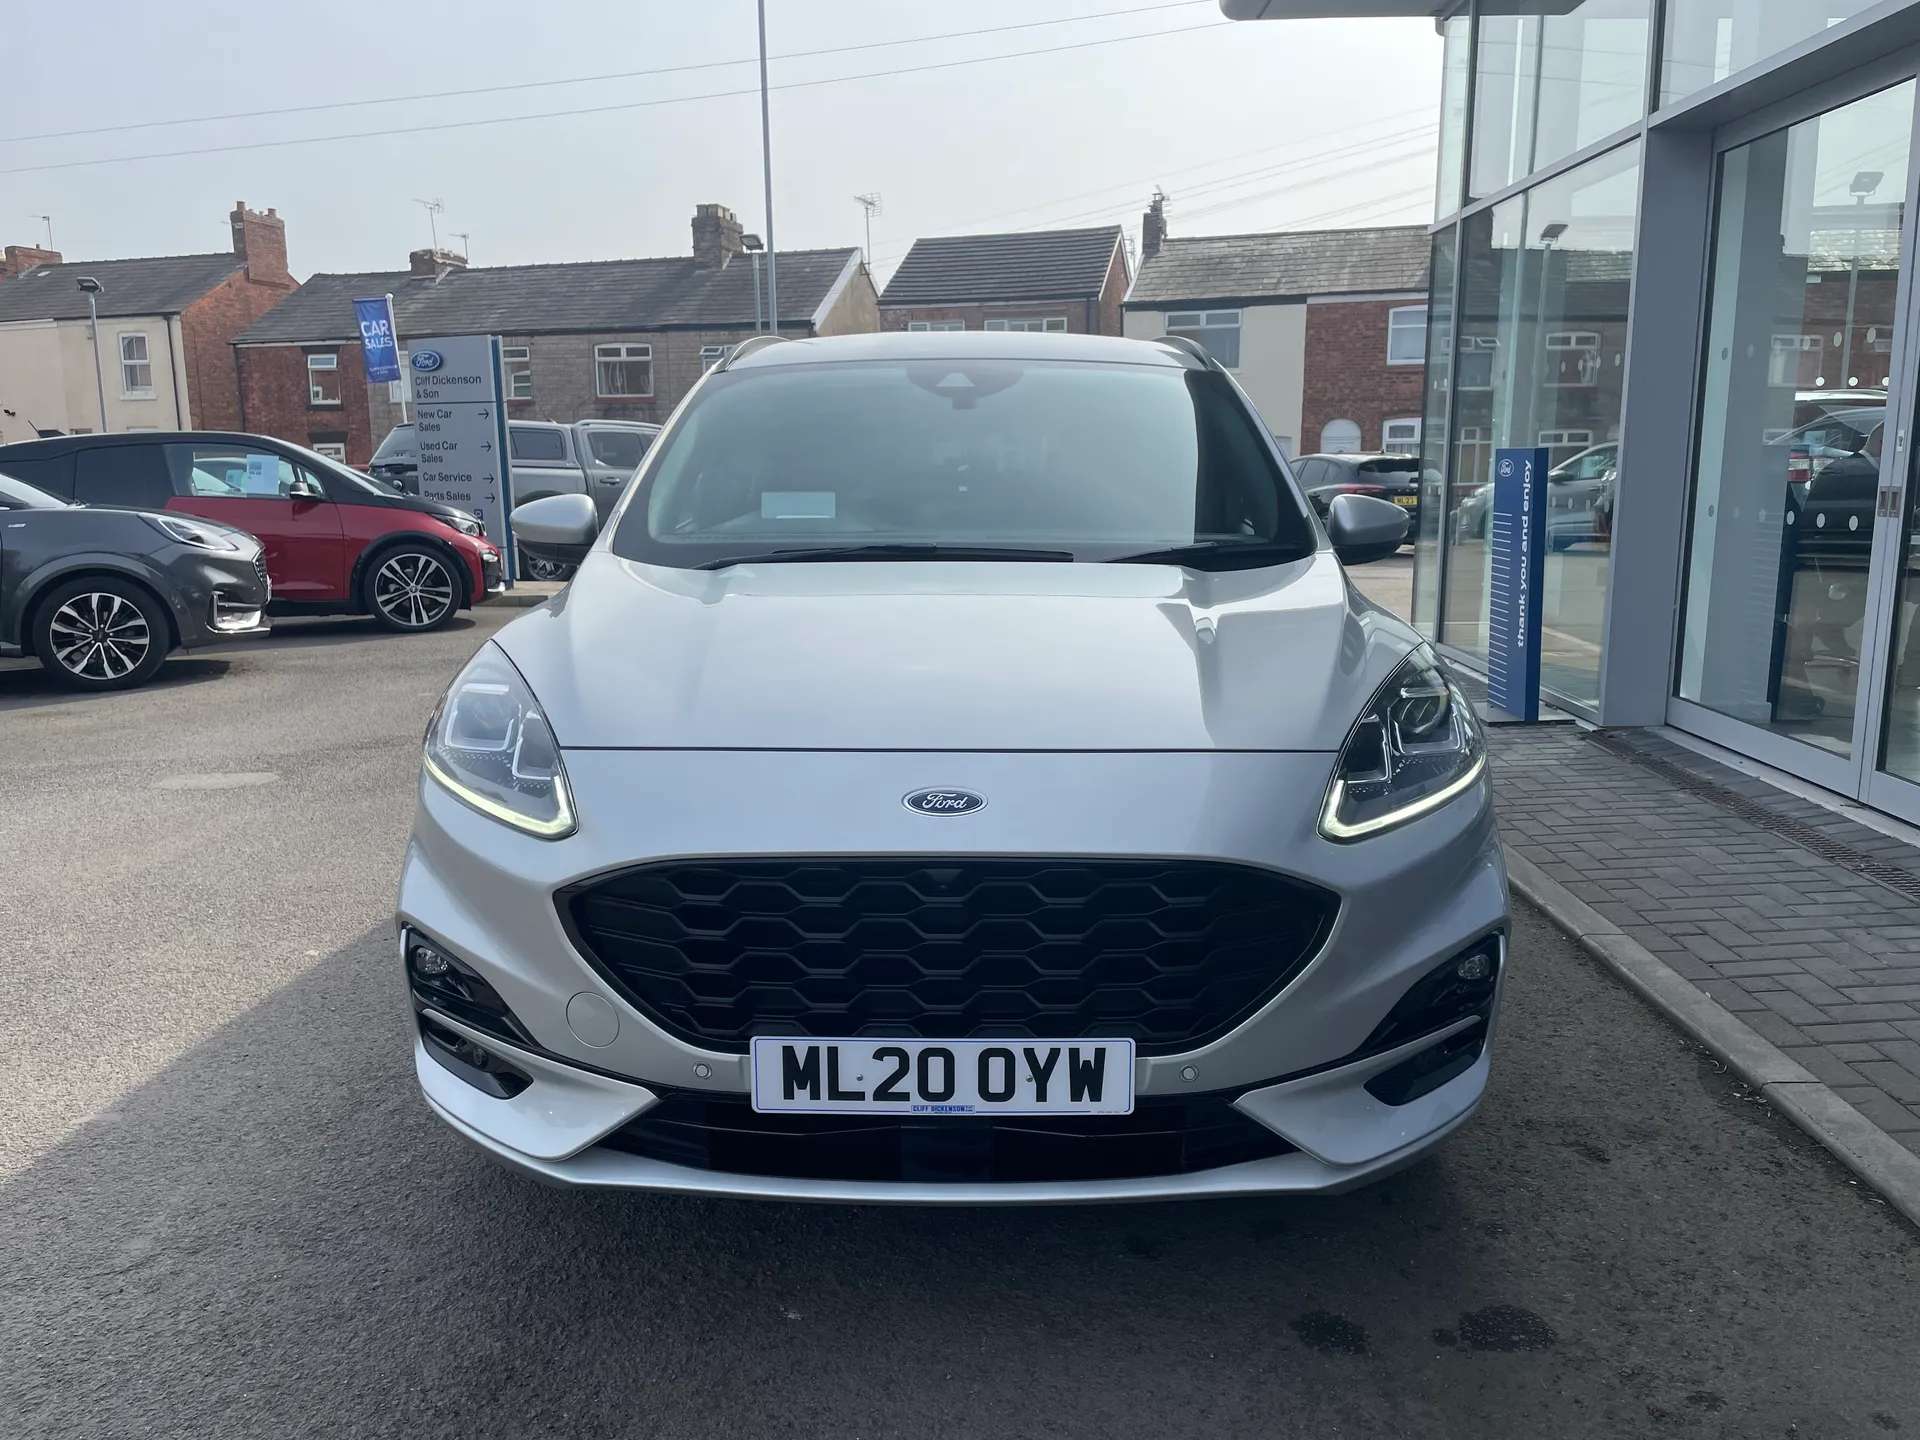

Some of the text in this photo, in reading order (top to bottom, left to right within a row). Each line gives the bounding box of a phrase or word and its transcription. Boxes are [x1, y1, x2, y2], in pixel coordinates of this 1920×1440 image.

[361, 319, 390, 336] CAR
[365, 336, 392, 350] SALES
[415, 374, 482, 386] Cliff Dickenson
[416, 388, 440, 399] & Son
[417, 409, 452, 419] New Car
[418, 422, 441, 432] Sales
[420, 440, 458, 451] Used Car
[421, 453, 443, 463] Sales
[422, 471, 473, 482] Car Service
[1522, 459, 1532, 513] enjoy
[424, 490, 471, 501] Parts Sales
[1521, 515, 1529, 553] and
[1517, 594, 1526, 648] thank
[922, 793, 968, 809] Ford
[781, 1045, 1107, 1103] ML20 OYW
